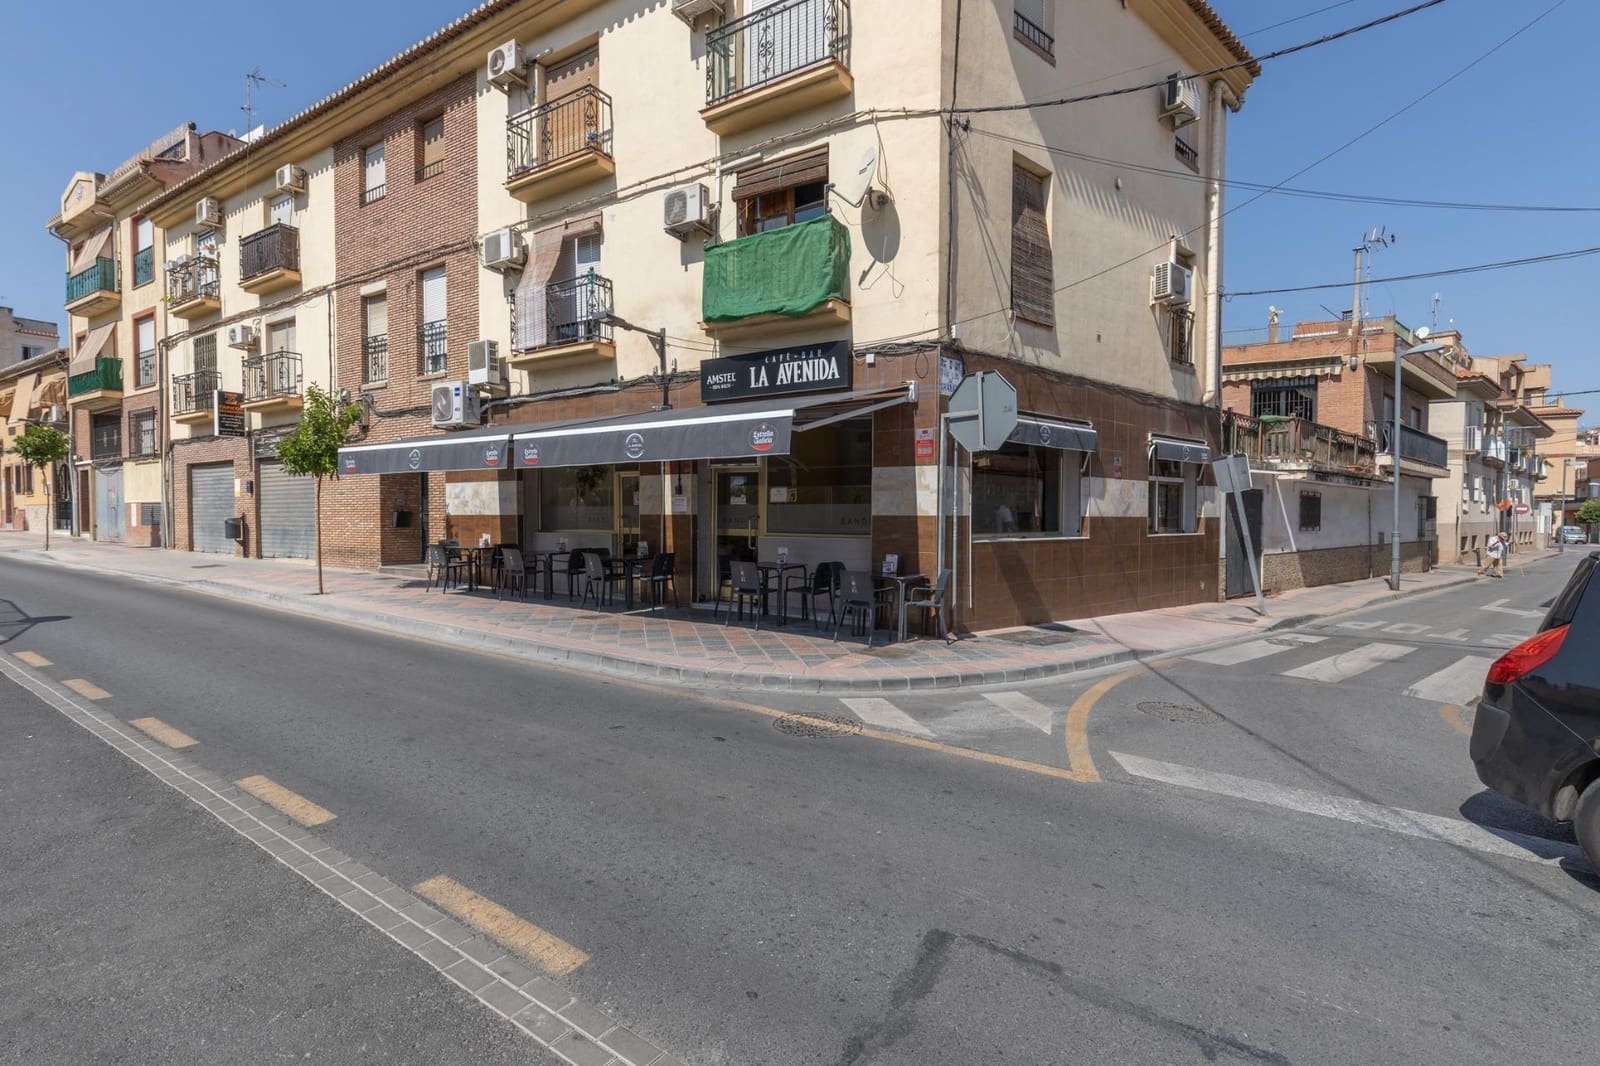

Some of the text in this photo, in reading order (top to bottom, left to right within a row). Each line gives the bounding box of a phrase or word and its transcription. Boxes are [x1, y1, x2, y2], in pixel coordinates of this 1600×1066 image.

[706, 372, 736, 385] AMSTEL
[749, 356, 840, 388] LA AVENIDA
[753, 430, 774, 439] Estrella
